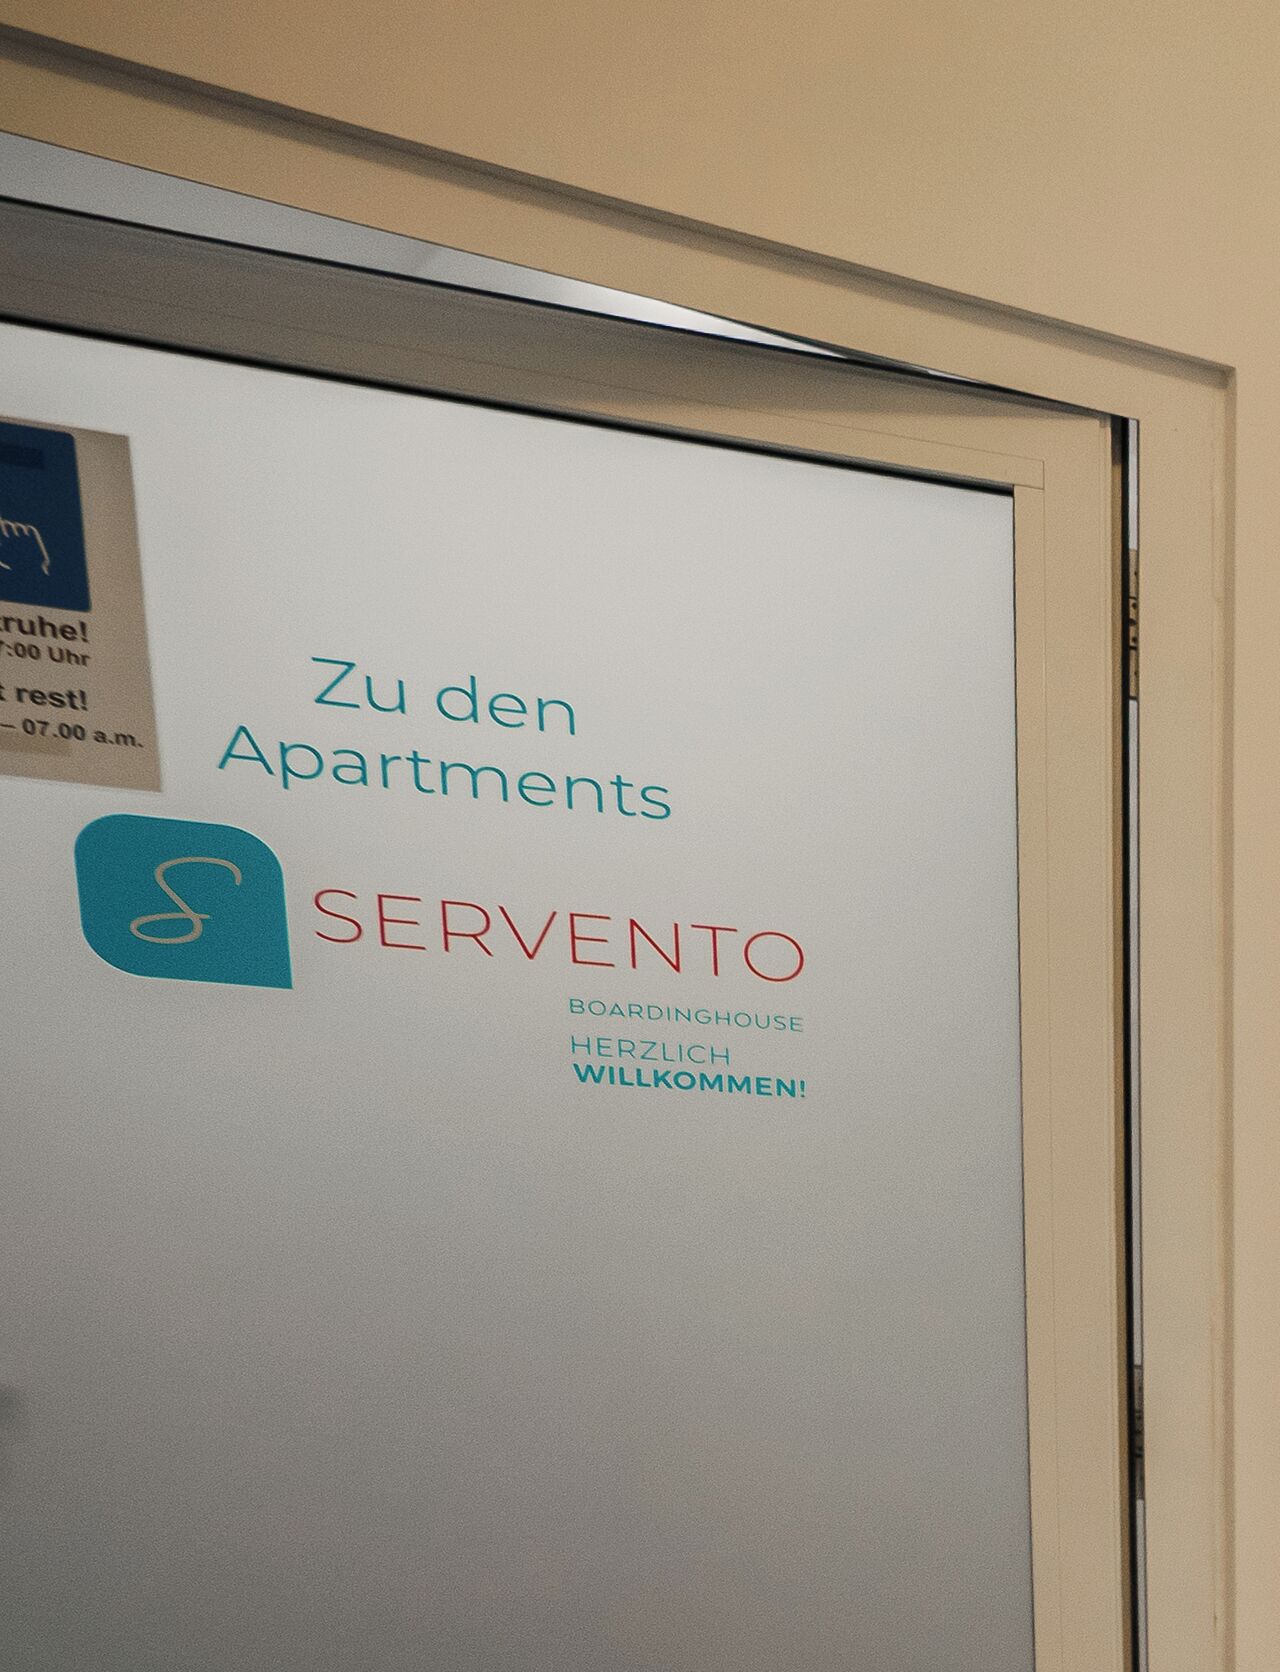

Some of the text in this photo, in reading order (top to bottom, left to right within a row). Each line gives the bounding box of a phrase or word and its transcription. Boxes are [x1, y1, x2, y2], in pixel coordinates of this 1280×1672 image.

[0, 612, 90, 644] ruhe!
[47, 646, 90, 668] Uhr
[14, 687, 89, 712] rest!
[310, 656, 578, 736] Zu den
[22, 717, 145, 748] 07.00 a.m.
[218, 724, 673, 821] Apartments
[312, 889, 806, 984] SERVENTO
[568, 997, 805, 1033] BOARDINGHOUSE
[571, 1035, 733, 1066] HERZLICH
[572, 1063, 807, 1099] WILLKOMMEN!
